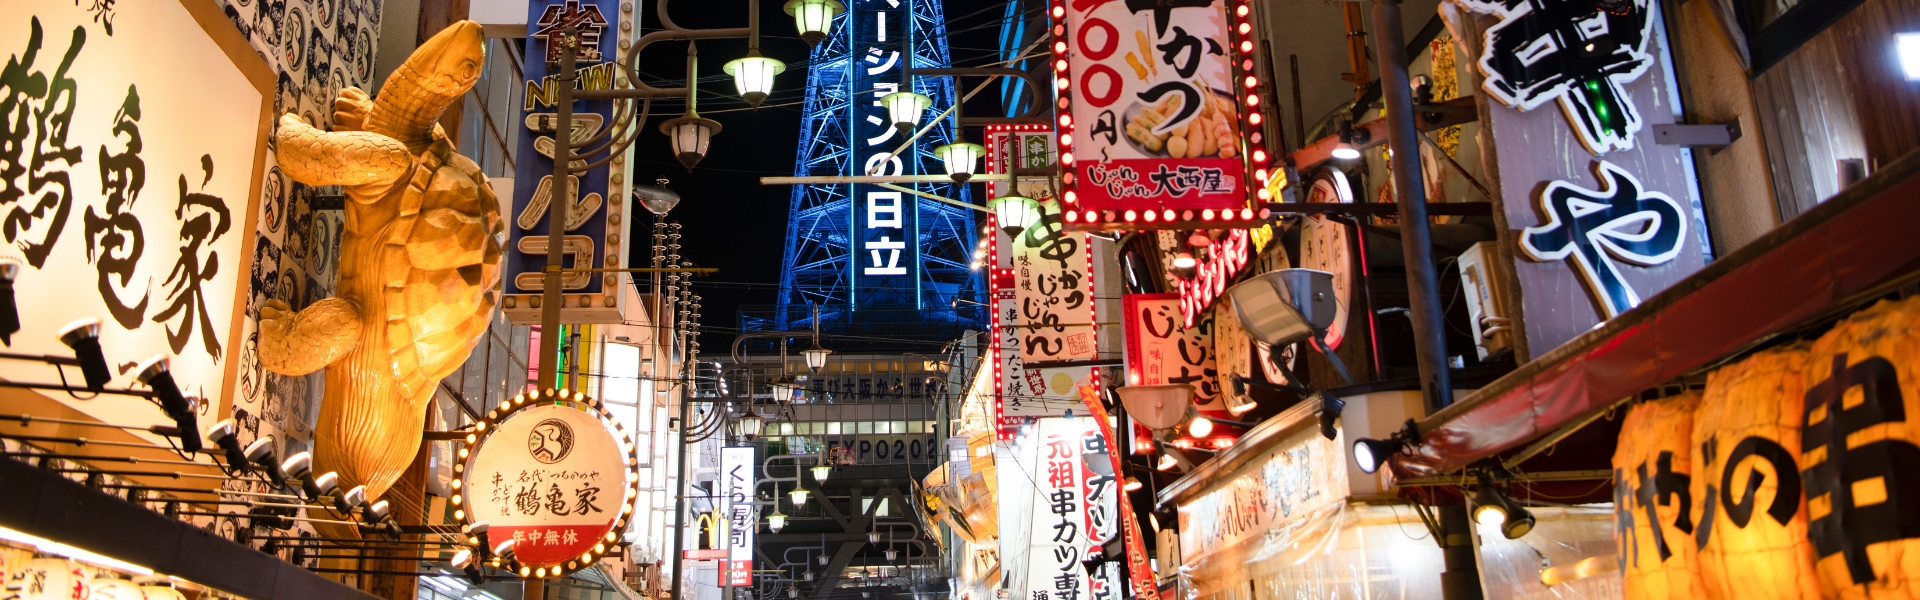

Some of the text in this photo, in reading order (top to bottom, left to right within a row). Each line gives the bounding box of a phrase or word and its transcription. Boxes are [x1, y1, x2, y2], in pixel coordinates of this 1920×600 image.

[864, 0, 907, 275] ーションの日立
[0, 15, 231, 365] 鶴亀家
[1150, 163, 1233, 198] 大西屋
[515, 112, 604, 291] マルコ
[1017, 250, 1033, 292] 味自慢
[550, 470, 600, 482] つるかめや
[514, 481, 604, 516] 鶴亀家
[511, 529, 579, 547] 年中無休
